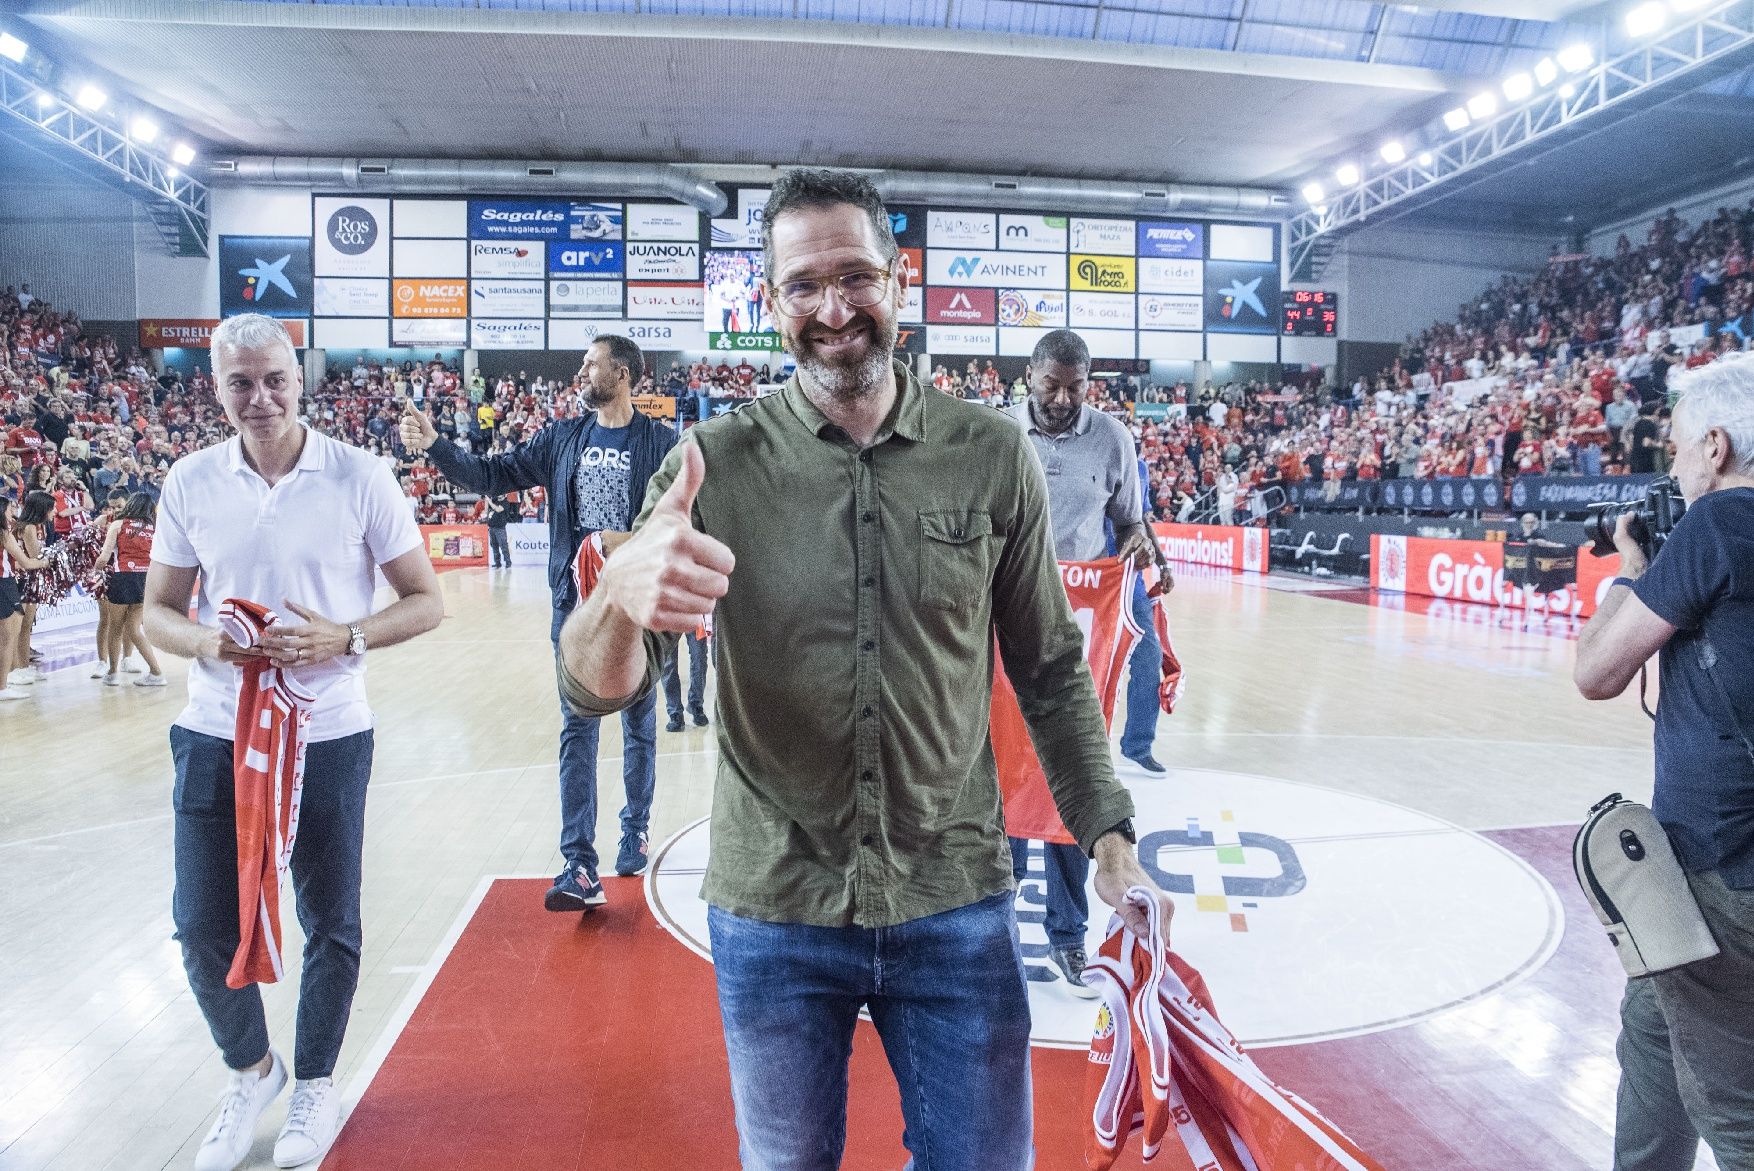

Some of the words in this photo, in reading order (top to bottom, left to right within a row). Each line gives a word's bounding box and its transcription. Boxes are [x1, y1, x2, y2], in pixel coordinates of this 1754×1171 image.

[481, 209, 565, 223] Sagalés
[338, 216, 370, 234] Ros
[487, 225, 558, 234] www.sagales.com
[629, 245, 696, 257] JUANOLA
[980, 264, 1048, 277] AVINENT
[419, 285, 465, 297] NACEX
[488, 285, 543, 296] santasusana
[1099, 309, 1120, 318] GOL
[475, 322, 541, 333] Sagalés
[628, 326, 672, 338] sarsa
[736, 335, 773, 348] COTS
[963, 333, 991, 344] sarsa
